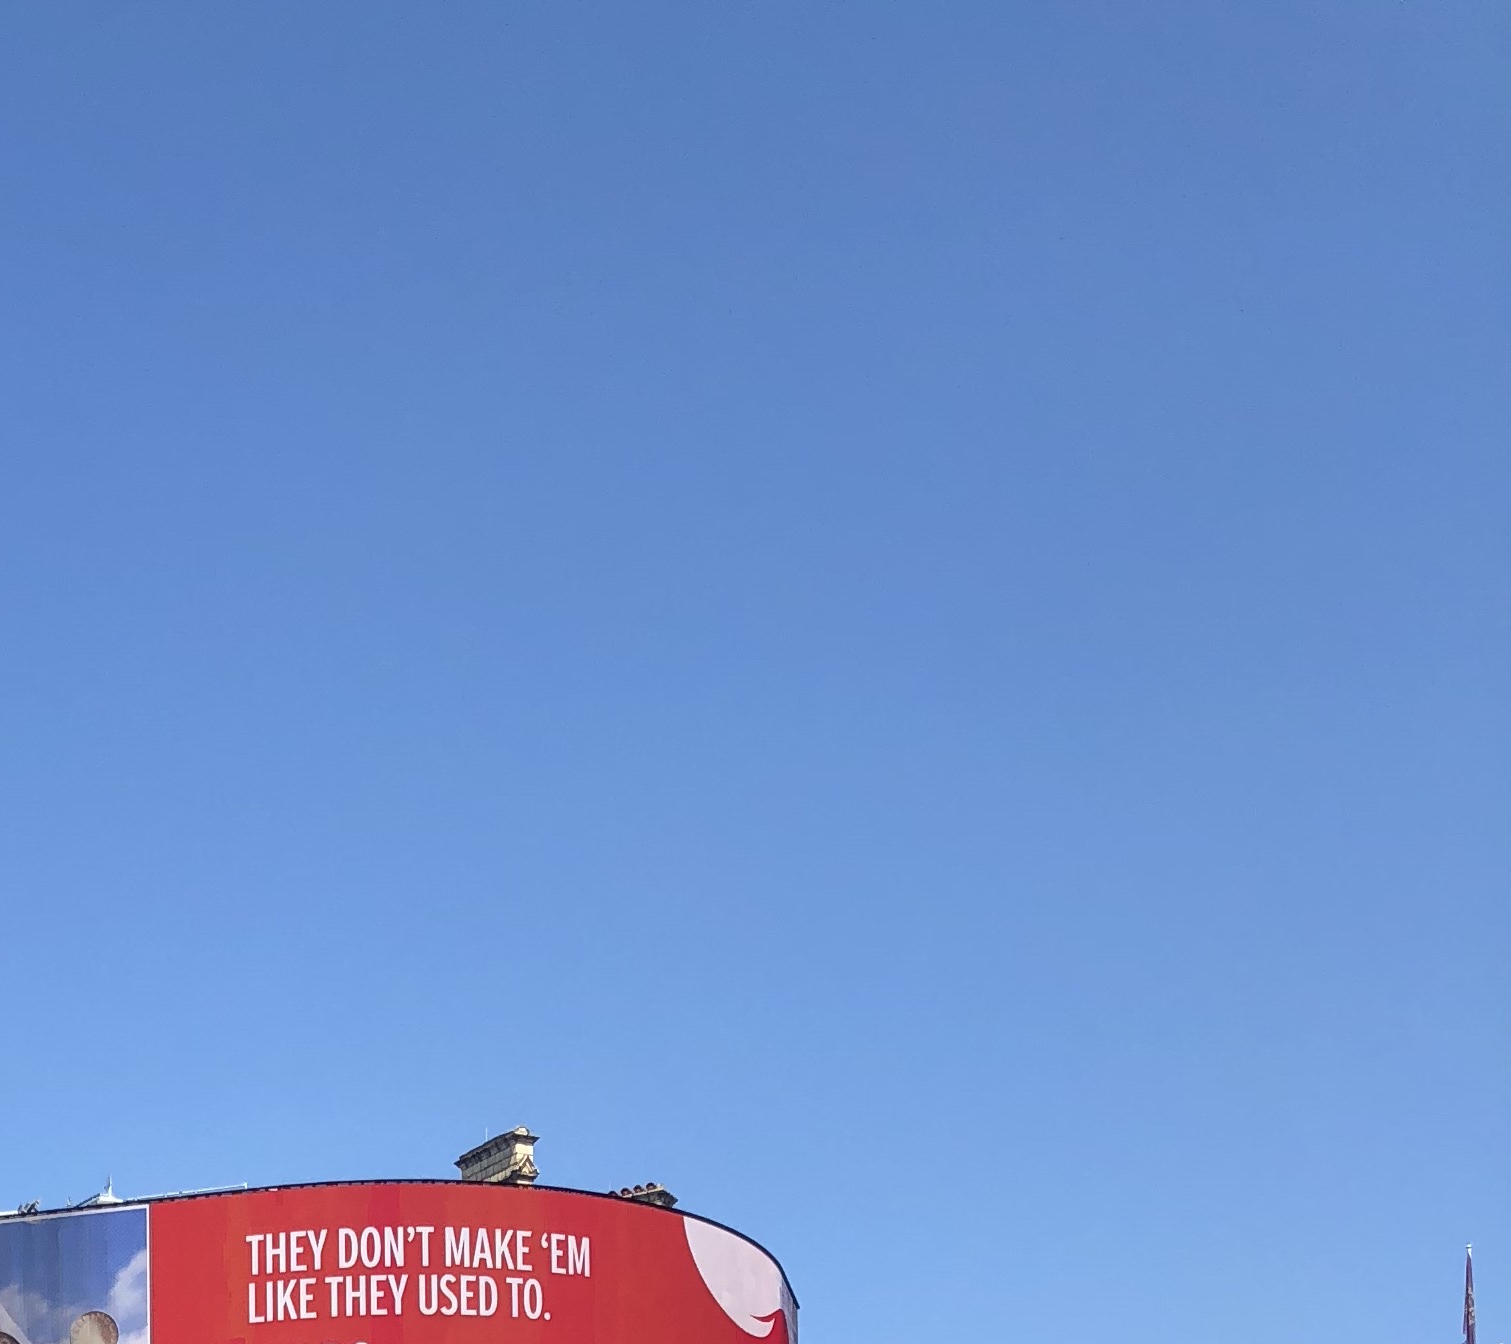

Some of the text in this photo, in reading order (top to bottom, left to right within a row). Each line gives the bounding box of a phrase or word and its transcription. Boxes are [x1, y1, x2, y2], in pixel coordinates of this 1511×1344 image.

[246, 1229, 328, 1275] THEY
[339, 1226, 434, 1269] DON’T
[445, 1226, 532, 1271] MAKE
[248, 1274, 551, 1323] LIKE THEY USED TO.
